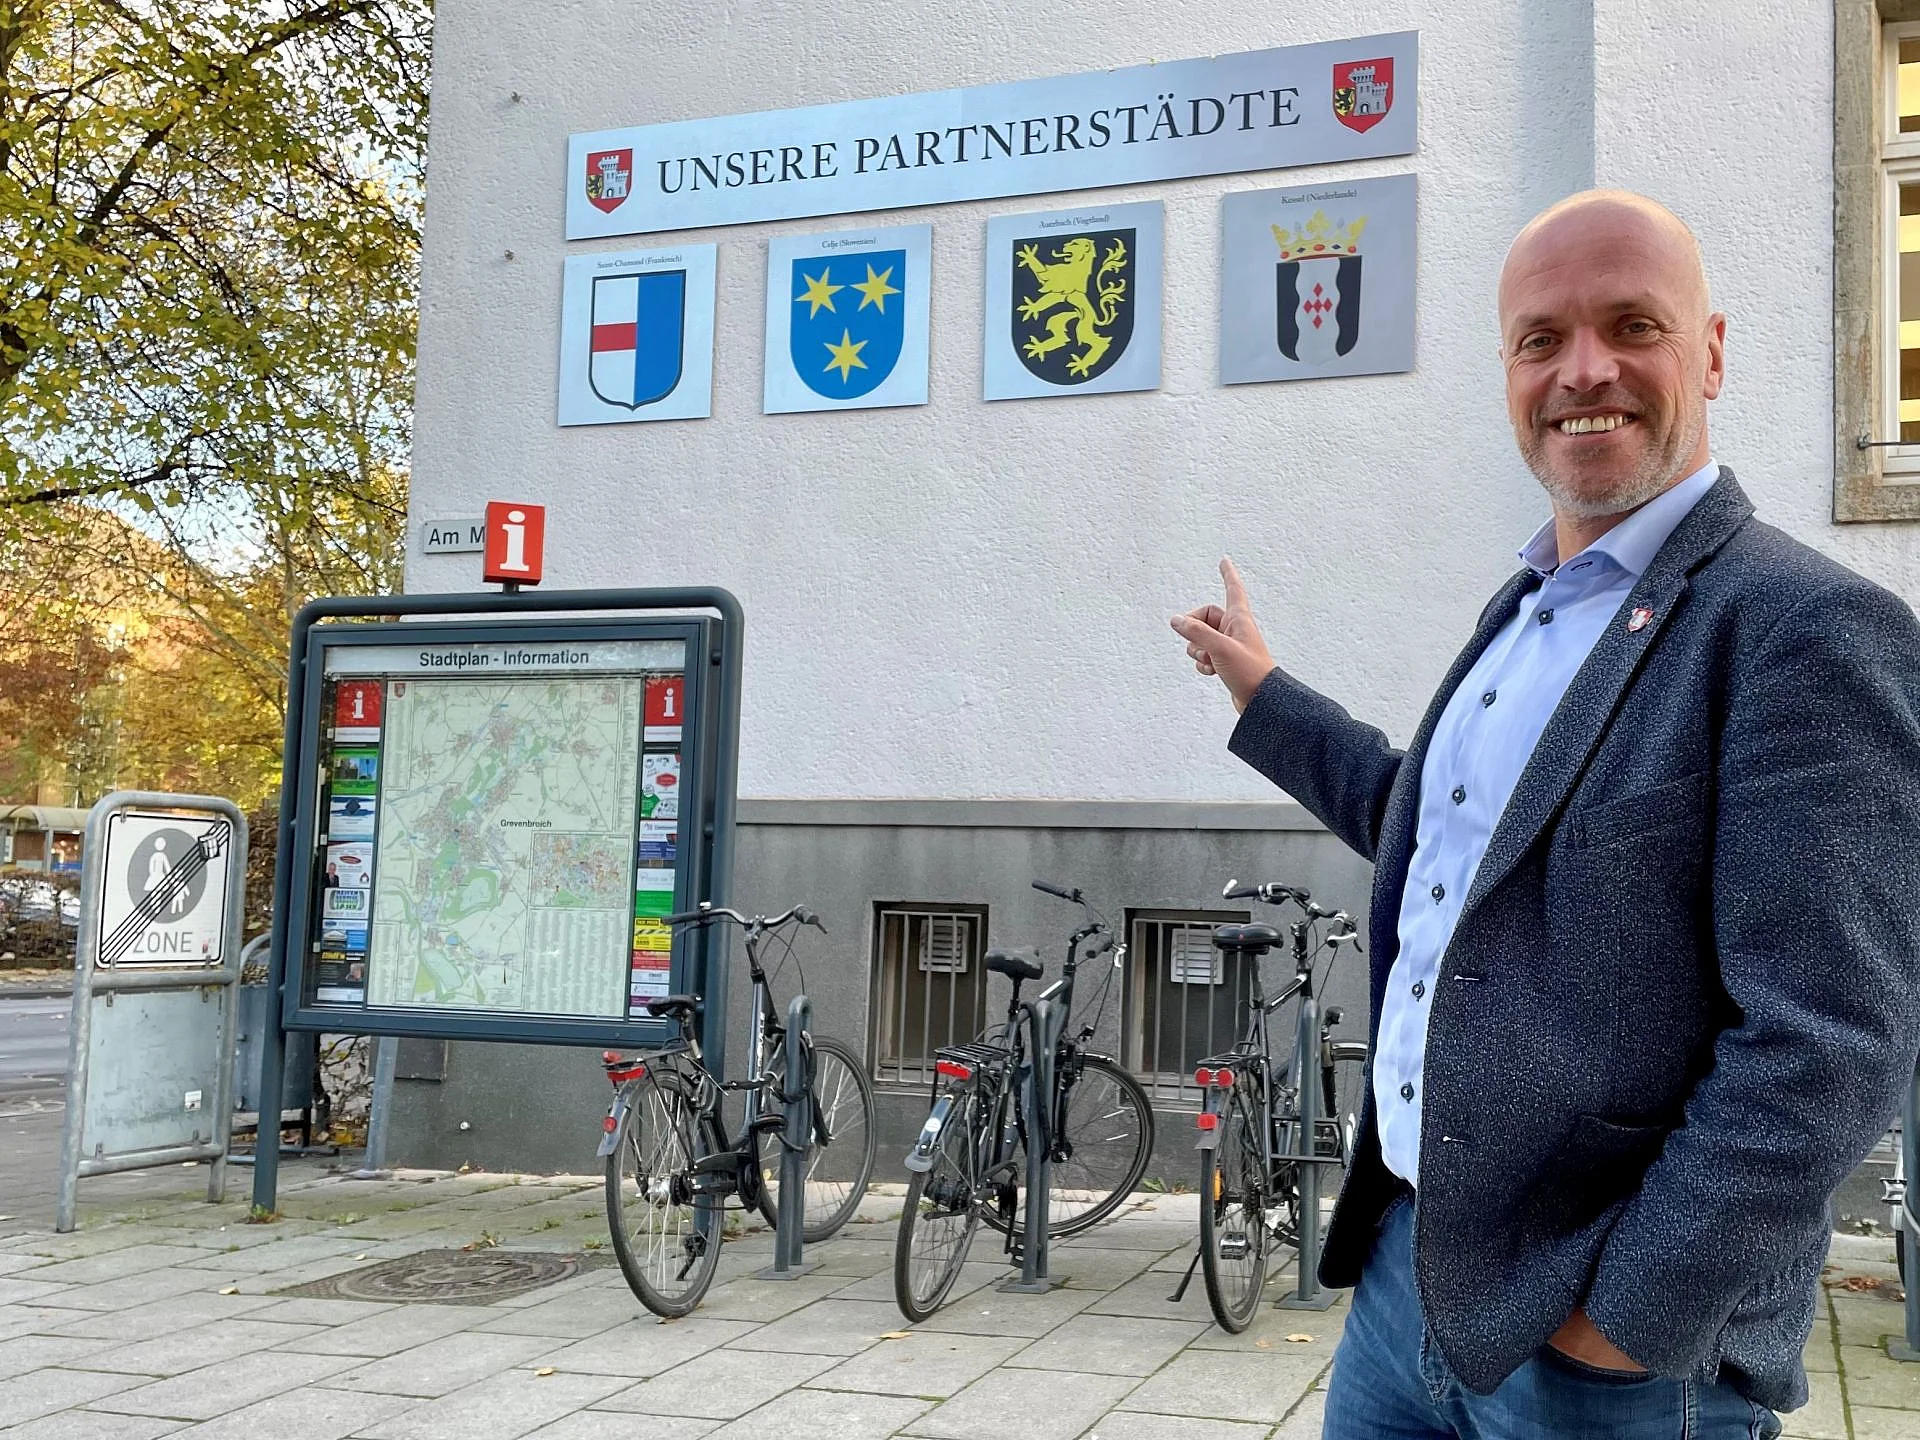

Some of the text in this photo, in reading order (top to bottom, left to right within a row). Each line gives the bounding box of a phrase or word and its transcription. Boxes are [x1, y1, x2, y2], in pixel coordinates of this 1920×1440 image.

[657, 87, 1301, 195] UNSERE PARTNERSTÄDTE
[428, 526, 485, 546] Am M
[419, 652, 489, 669] Stadtplan
[503, 650, 589, 665] Information
[500, 819, 552, 828] Grevenbroich
[132, 931, 193, 953] ZONE
